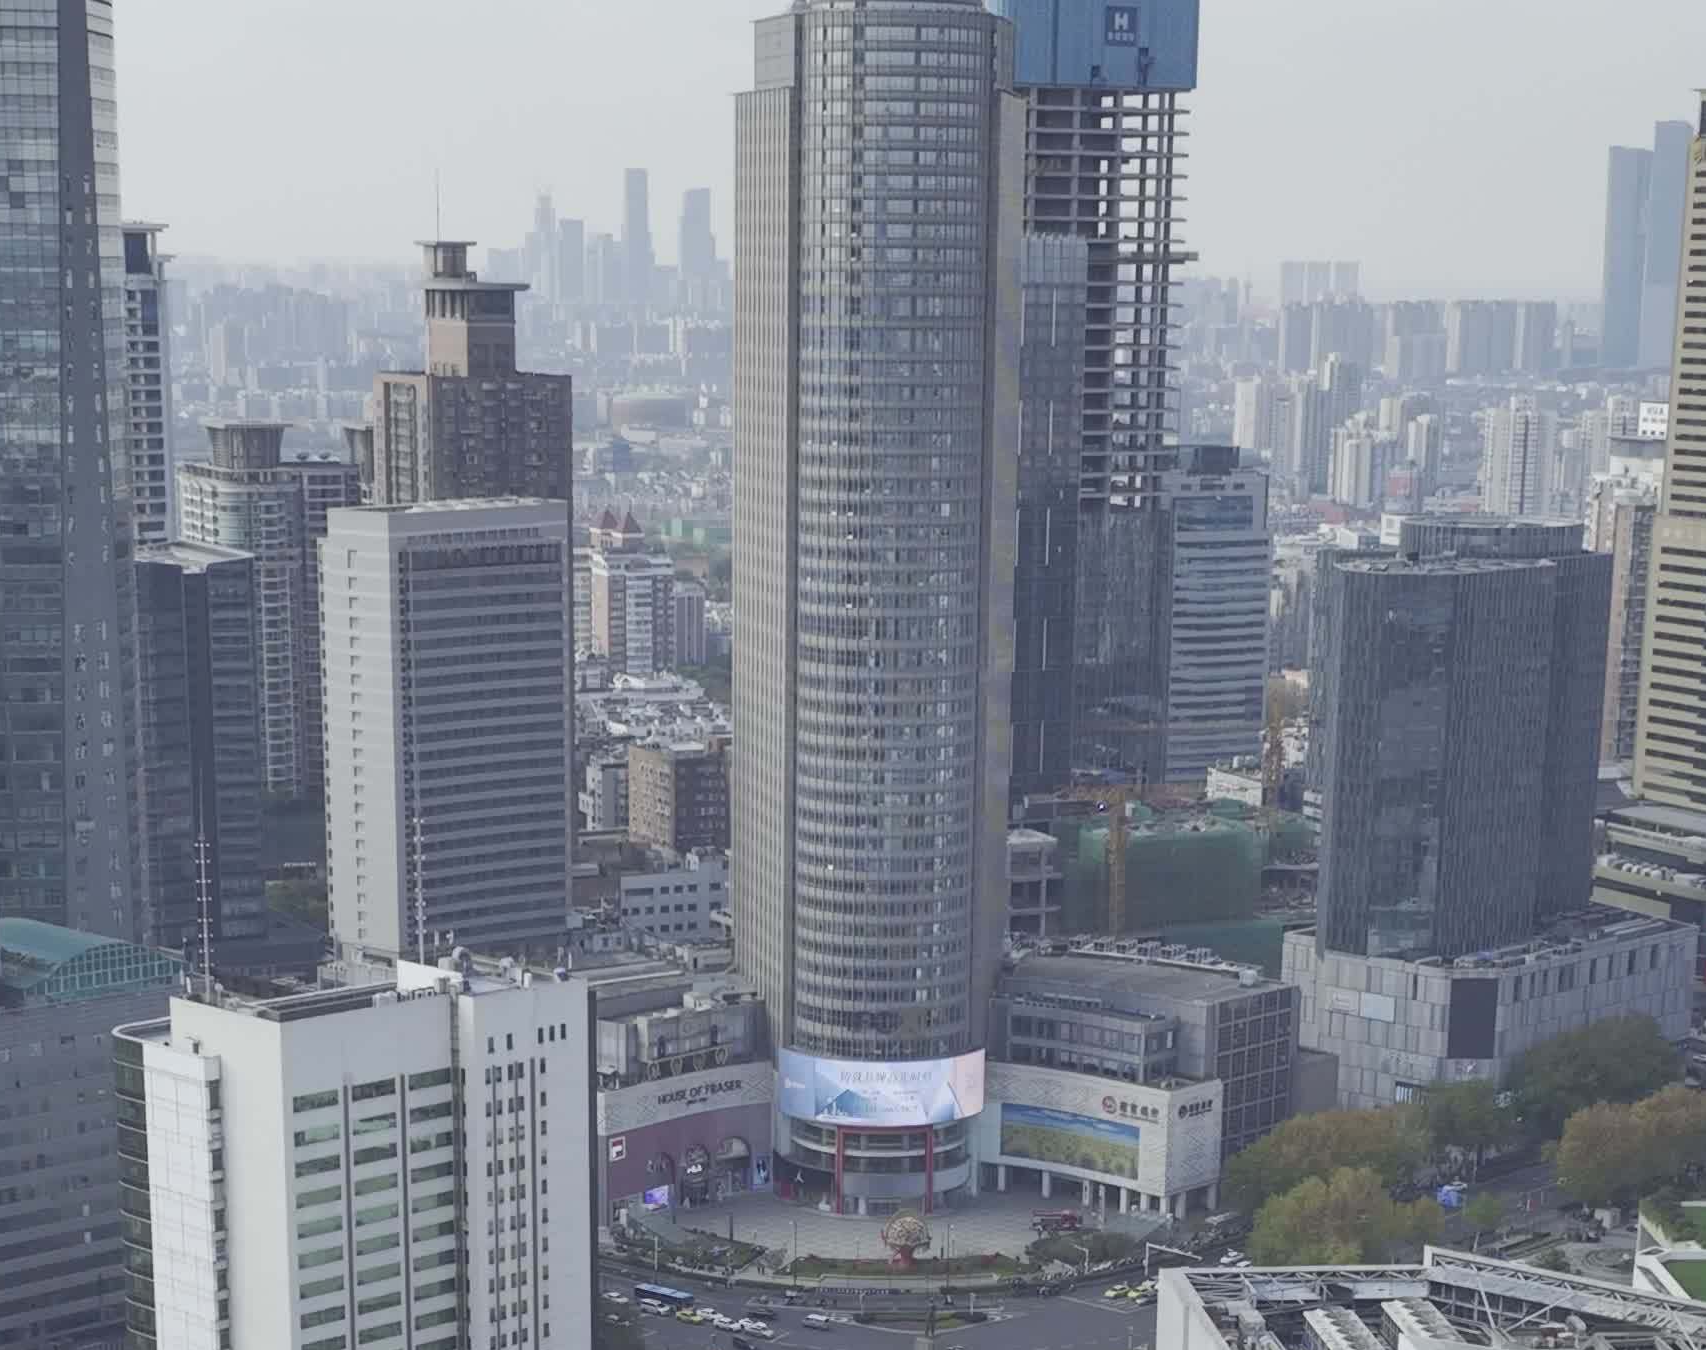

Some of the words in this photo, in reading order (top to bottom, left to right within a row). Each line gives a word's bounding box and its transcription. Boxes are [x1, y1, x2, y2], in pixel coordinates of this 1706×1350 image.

[658, 1090, 687, 1105] HOUSE
[689, 1086, 702, 1098] OF
[704, 1080, 742, 1095] FRASER
